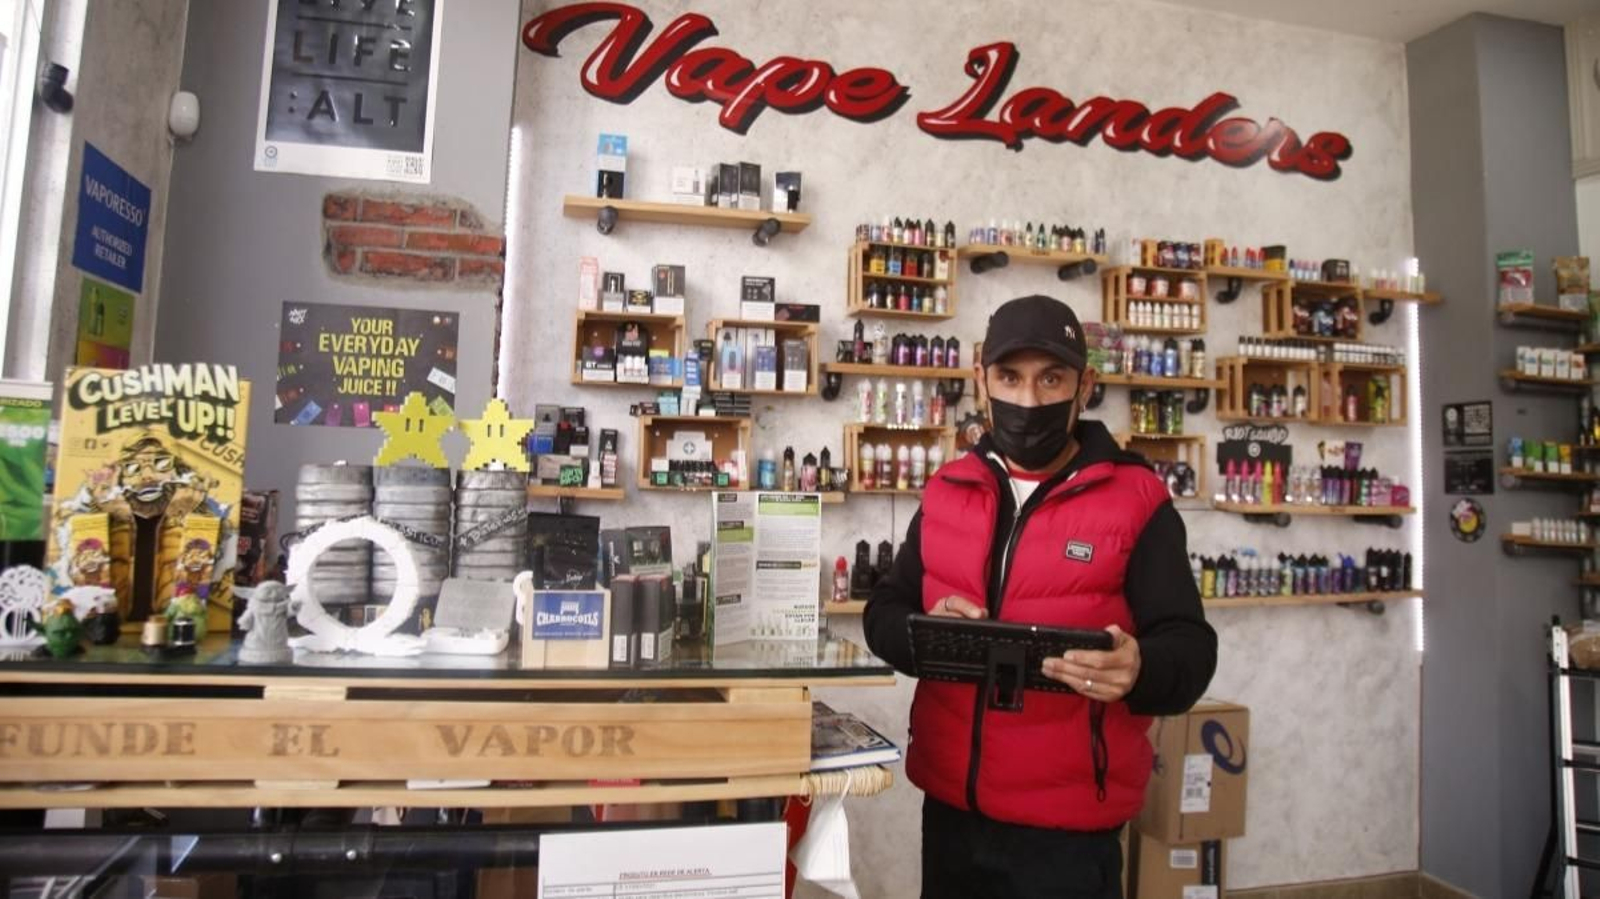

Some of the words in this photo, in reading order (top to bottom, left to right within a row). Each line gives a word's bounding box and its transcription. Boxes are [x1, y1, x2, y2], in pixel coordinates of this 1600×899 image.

[292, 30, 411, 71] LIFE
[522, 1, 909, 134] Vape
[917, 41, 1353, 180] Landers
[85, 174, 143, 226] VAPORESSO
[351, 317, 393, 335] YOUR
[318, 333, 420, 357] EVERYDAY
[78, 363, 240, 403] CUSHMAN
[332, 356, 405, 378] VAPING
[106, 397, 173, 429] LEVEL
[267, 723, 341, 758] EL
[434, 724, 636, 758] VAPOR
